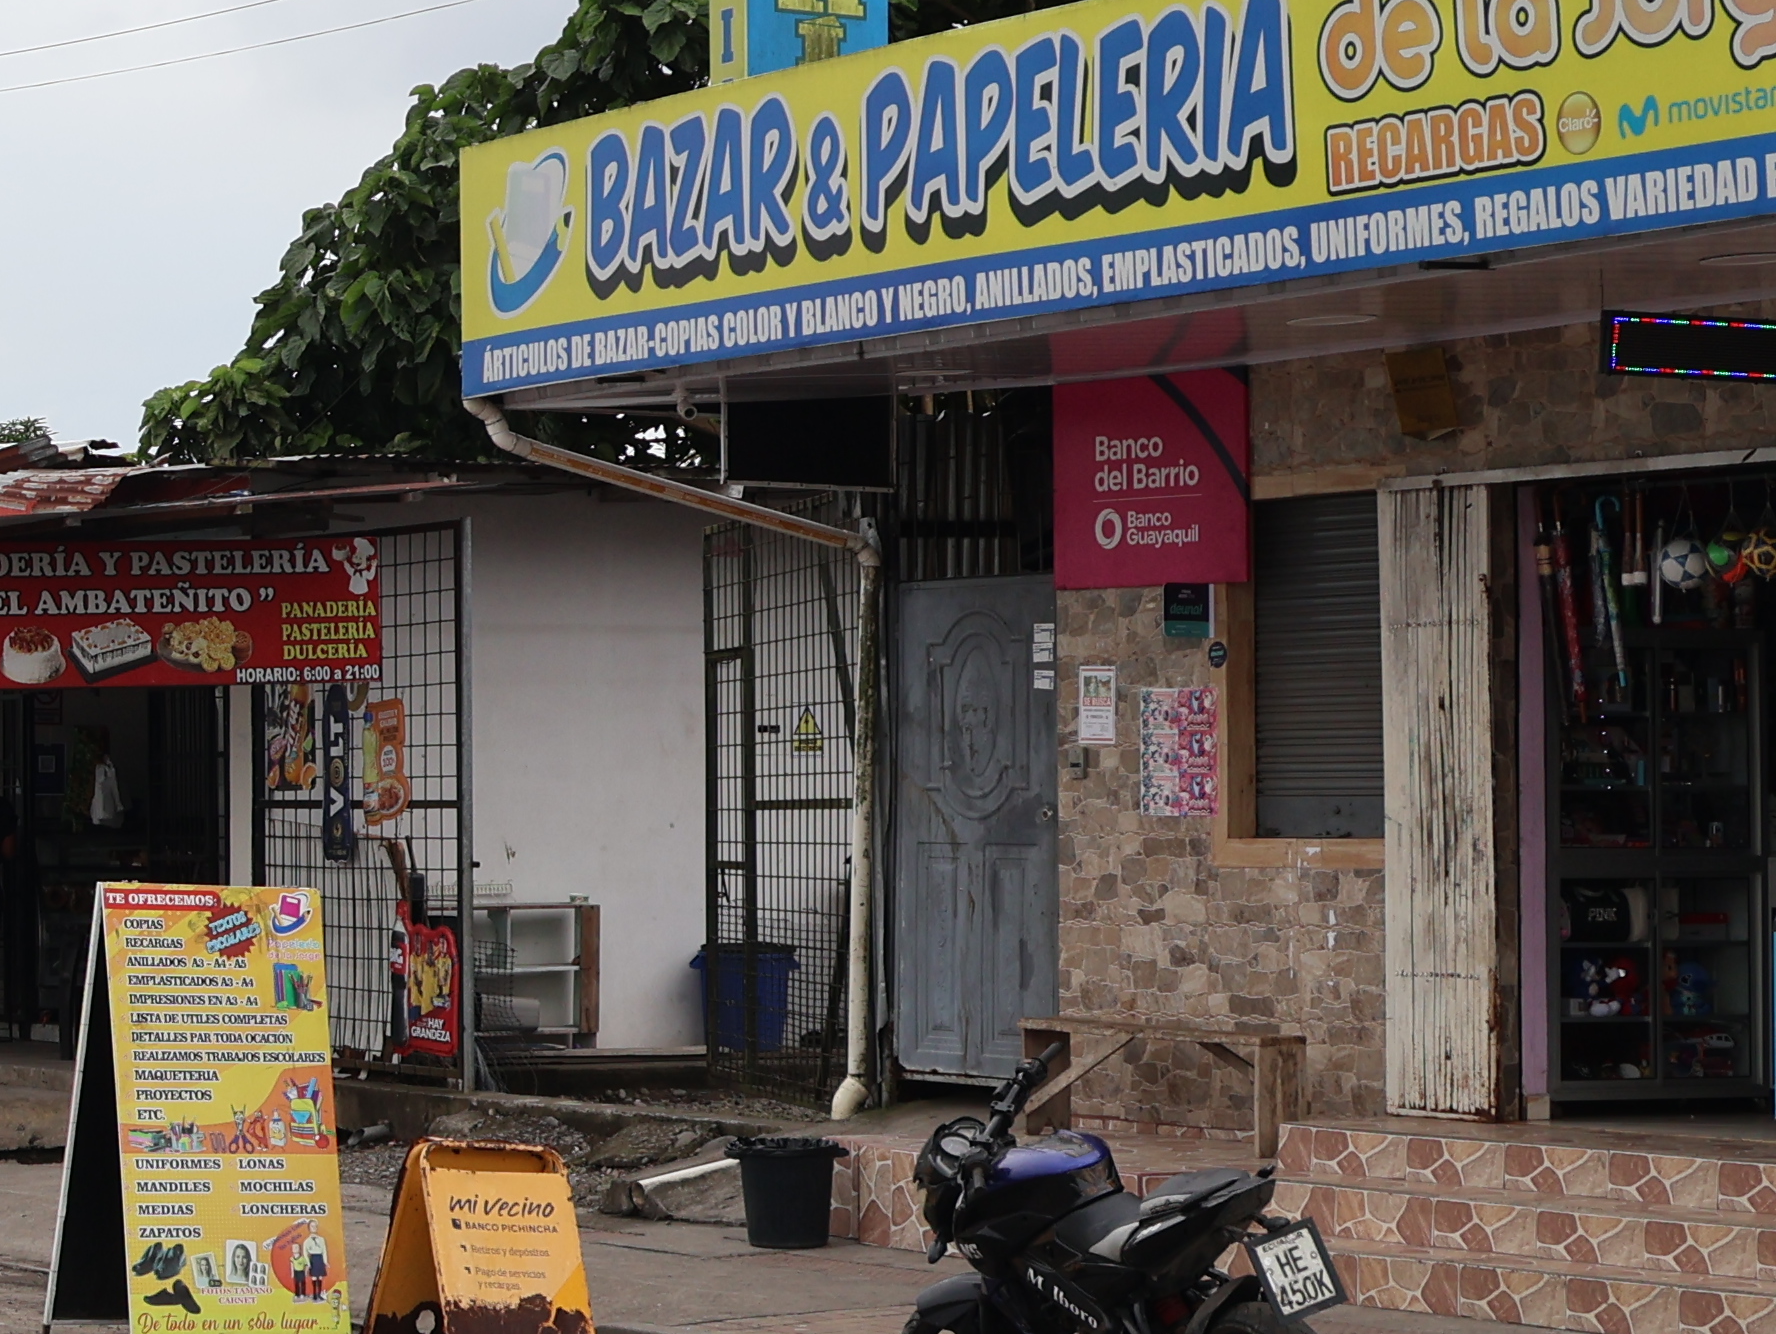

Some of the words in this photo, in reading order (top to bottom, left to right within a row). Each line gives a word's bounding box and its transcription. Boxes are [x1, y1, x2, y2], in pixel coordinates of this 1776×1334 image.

[1324, 89, 1545, 196] RECARGAS
[1558, 110, 1597, 133] Claro
[586, 93, 797, 281] BAZAR
[802, 111, 850, 241] &
[483, 337, 568, 384] ÁRTICULOS
[572, 334, 591, 366] DE
[594, 315, 720, 364] BAZAR-COPIAS
[723, 307, 781, 350] COLOR
[785, 302, 799, 336] Y
[802, 291, 877, 335] BLANCO
[882, 285, 896, 323] Y
[899, 274, 971, 322] NEGRO,
[975, 257, 1098, 310] ANILLADOS,
[1102, 225, 1305, 293] EMPLASTICADOS,
[1310, 200, 1470, 264] UNIFORMES,
[1474, 181, 1600, 240] REGALOS
[1605, 154, 1758, 221] VARIEDAD
[1095, 436, 1163, 461] Banco
[1095, 463, 1127, 492] del
[1133, 458, 1199, 490] Barrio
[1127, 511, 1172, 528] Banco
[1126, 524, 1199, 548] Guayaquil
[99, 551, 123, 576] Y
[130, 543, 331, 576] PASTELERÍA
[34, 582, 252, 615] AMBATEÑITO
[281, 597, 377, 618] PANADERÍA
[282, 618, 376, 641] PASTELERÍA
[283, 640, 368, 660] DULCERÍA
[236, 667, 300, 683] HORARIO:
[303, 665, 331, 681] 6:00
[334, 668, 342, 679] a
[345, 664, 380, 680] 21:00
[1092, 697, 1112, 706] BUSCA
[106, 893, 125, 904] TE
[130, 894, 218, 906] OFRECEMOS:
[124, 919, 164, 930] COPIAS
[125, 937, 183, 949] RECARGAS
[126, 957, 187, 968] ANILLADOS
[191, 957, 204, 968] A3
[234, 958, 247, 968] A5
[128, 975, 218, 986] EMPLASTICADOS
[220, 976, 233, 987] A3
[241, 977, 254, 987] A4
[129, 994, 205, 1005] IMPRESIONES
[208, 995, 223, 1005] EN
[225, 995, 238, 1006] A3
[246, 996, 259, 1006] A4
[130, 1013, 162, 1024] LISTA
[164, 1013, 179, 1024] DE
[182, 1013, 220, 1024] UTILES
[222, 1013, 287, 1025] COMPLETAS
[428, 1017, 444, 1029] HAY
[132, 1032, 187, 1043] DETALLES
[190, 1032, 212, 1043] PAR
[215, 1032, 243, 1043] TODA
[246, 1031, 293, 1044] OCACIÓN
[411, 1026, 451, 1043] GRANDEZA
[133, 1051, 203, 1062] REALIZAMOS
[205, 1051, 260, 1062] TRABAJOS
[262, 1052, 326, 1063] ESCOLARES
[134, 1070, 219, 1081] MAQUETERIA
[136, 1089, 212, 1101] PROYECTOS
[137, 1109, 165, 1120] ETC.
[135, 1158, 221, 1169] UNIFORMES
[238, 1158, 285, 1169] LONAS
[136, 1181, 211, 1192] MANDILES
[240, 1181, 314, 1192] MOCHILAS
[138, 1204, 194, 1215] MEDIAS
[241, 1204, 326, 1216] LONCHERAS
[450, 1194, 479, 1215] mi
[139, 1227, 201, 1238] ZAPATOS
[465, 1221, 499, 1232] BANCO
[501, 1223, 558, 1234] PICHINCHA
[471, 1245, 501, 1255] Retiros
[1275, 1245, 1308, 1278] HE
[475, 1267, 496, 1278] Pago
[497, 1268, 507, 1277] de
[508, 1270, 546, 1279] servicios
[201, 1287, 231, 1296] FOTOS
[1279, 1269, 1333, 1310] 450K
[218, 1296, 257, 1304] CARNET
[138, 1312, 161, 1334] De
[162, 1312, 198, 1332] todo
[202, 1319, 219, 1331] en
[223, 1319, 243, 1331] un
